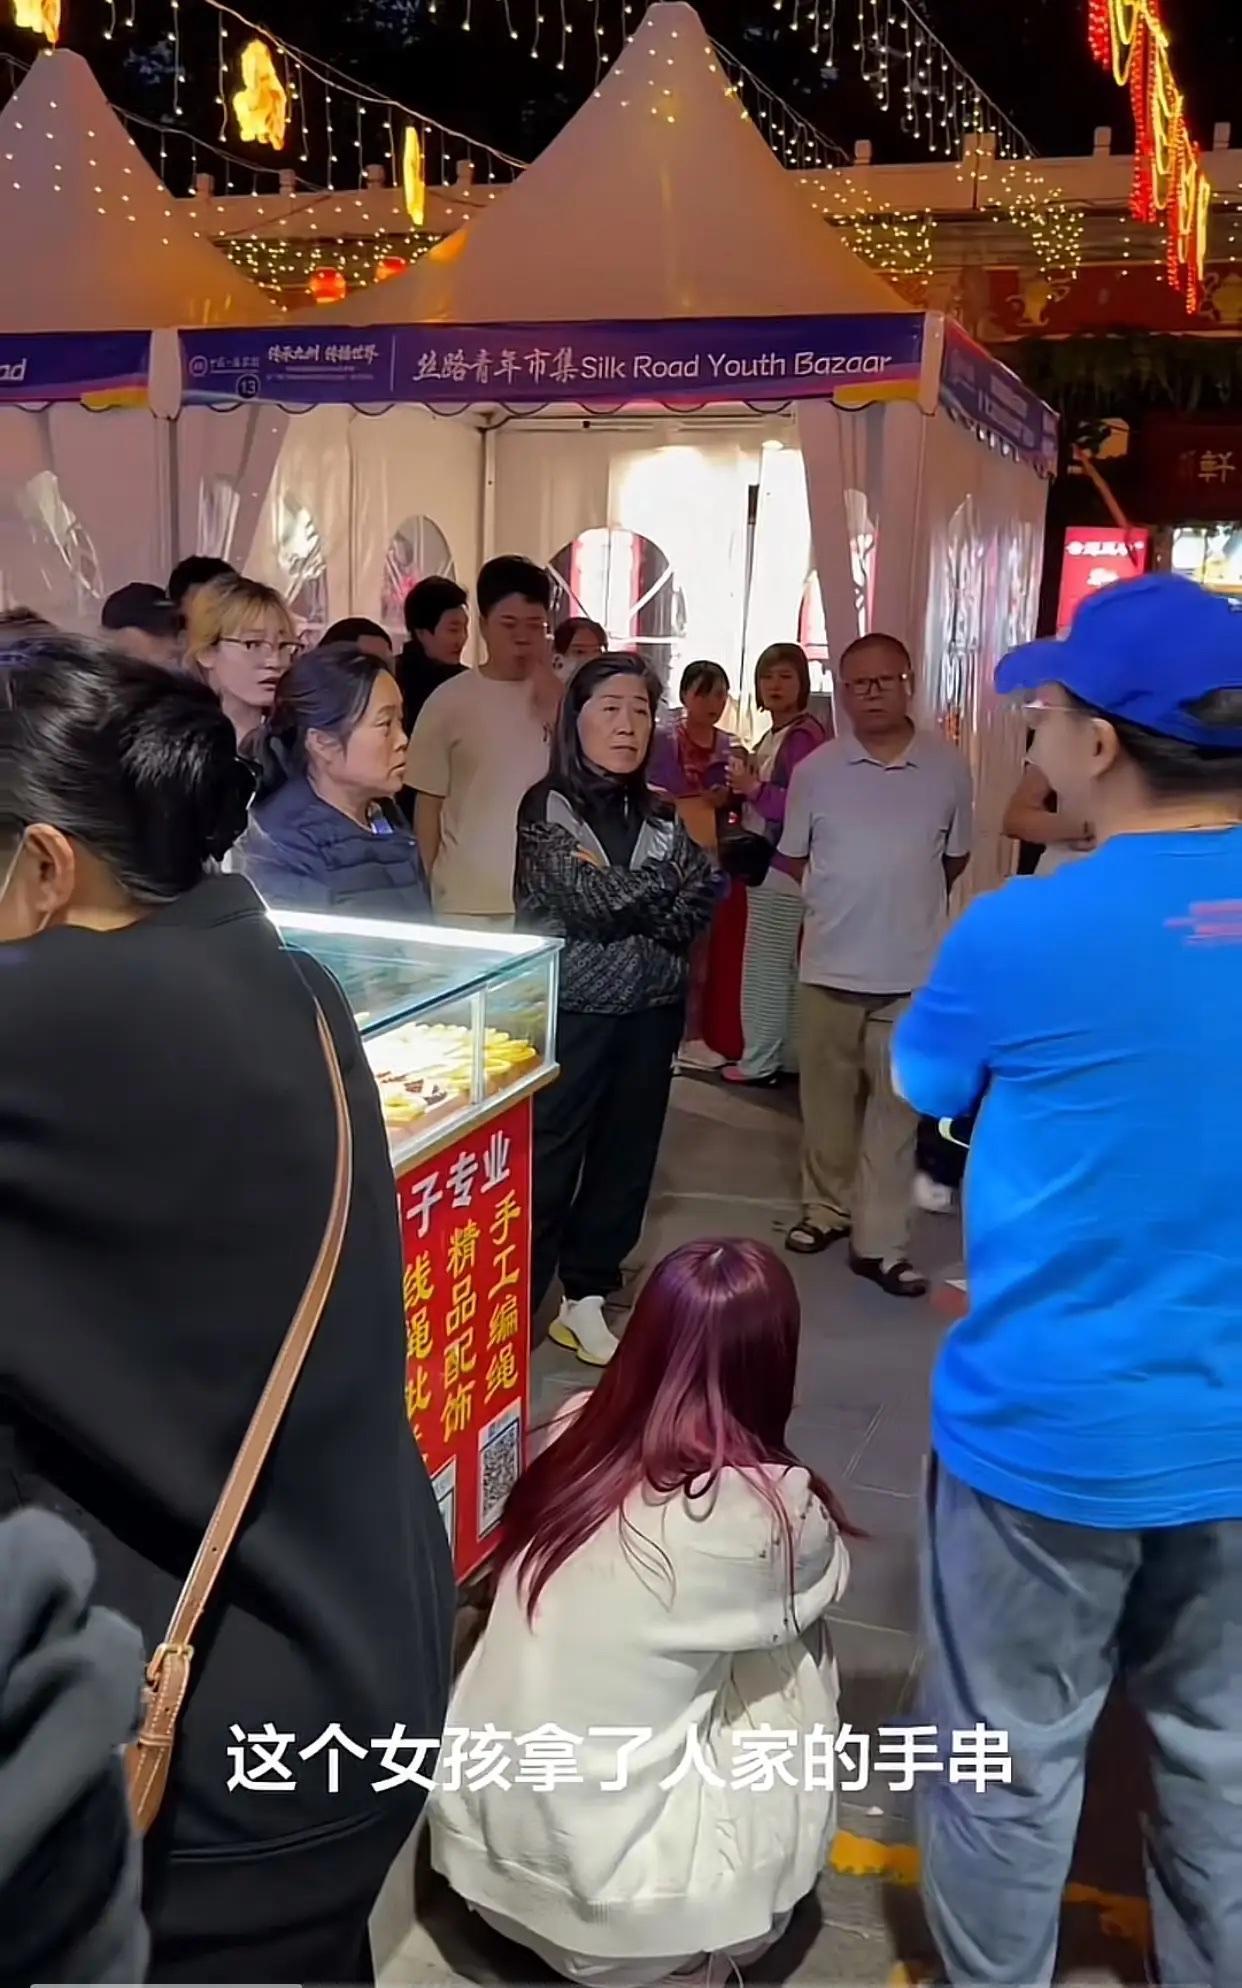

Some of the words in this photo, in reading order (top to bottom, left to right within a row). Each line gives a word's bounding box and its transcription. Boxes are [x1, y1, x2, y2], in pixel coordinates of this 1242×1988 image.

[412, 347, 579, 384] 丝路青年市集
[581, 356, 626, 379] Silk
[633, 355, 699, 378] Road
[708, 353, 785, 377] Youth
[794, 351, 892, 375] Bazaar
[440, 1218, 481, 1442] 精品配饰
[484, 1189, 521, 1404] 手工编绳
